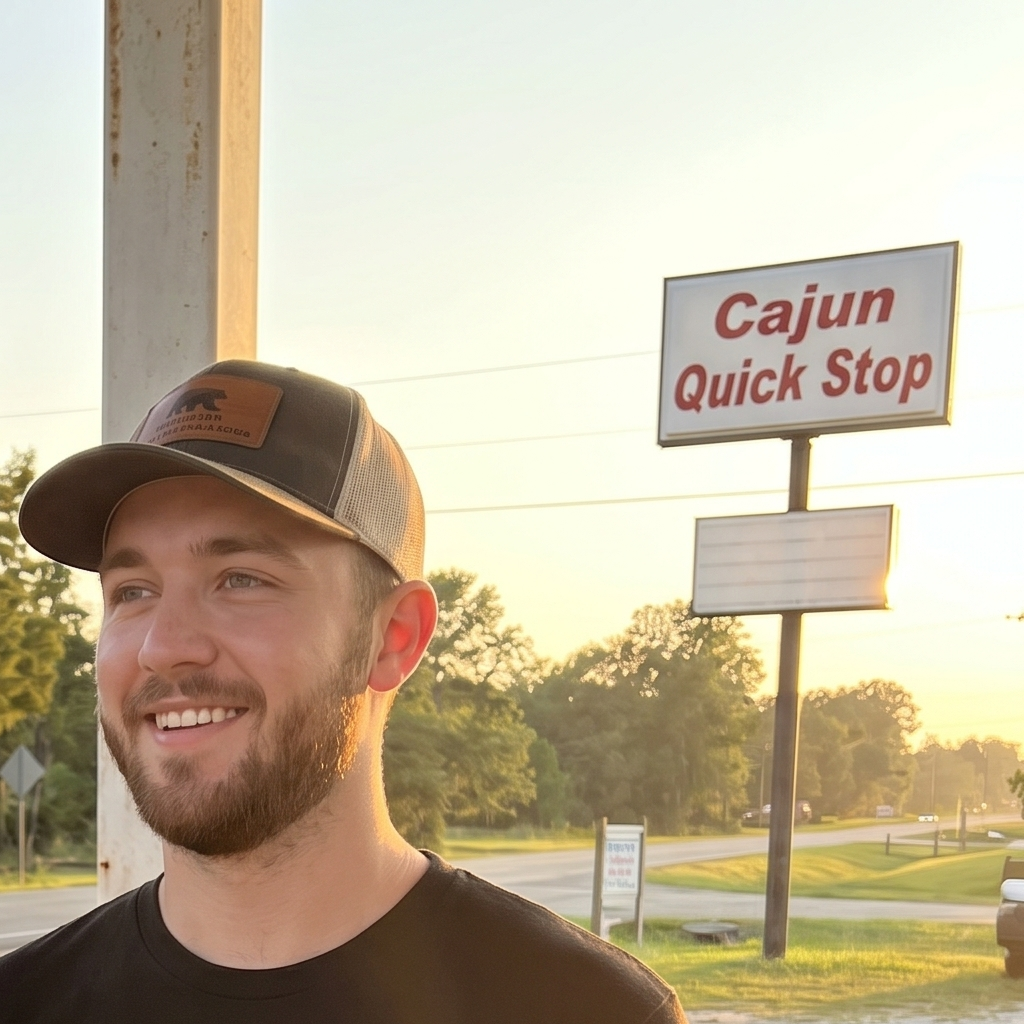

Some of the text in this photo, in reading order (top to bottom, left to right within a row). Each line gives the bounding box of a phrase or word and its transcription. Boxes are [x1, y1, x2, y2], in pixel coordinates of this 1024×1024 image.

[714, 283, 895, 345] Cajun
[674, 346, 933, 413] Quick Stop
